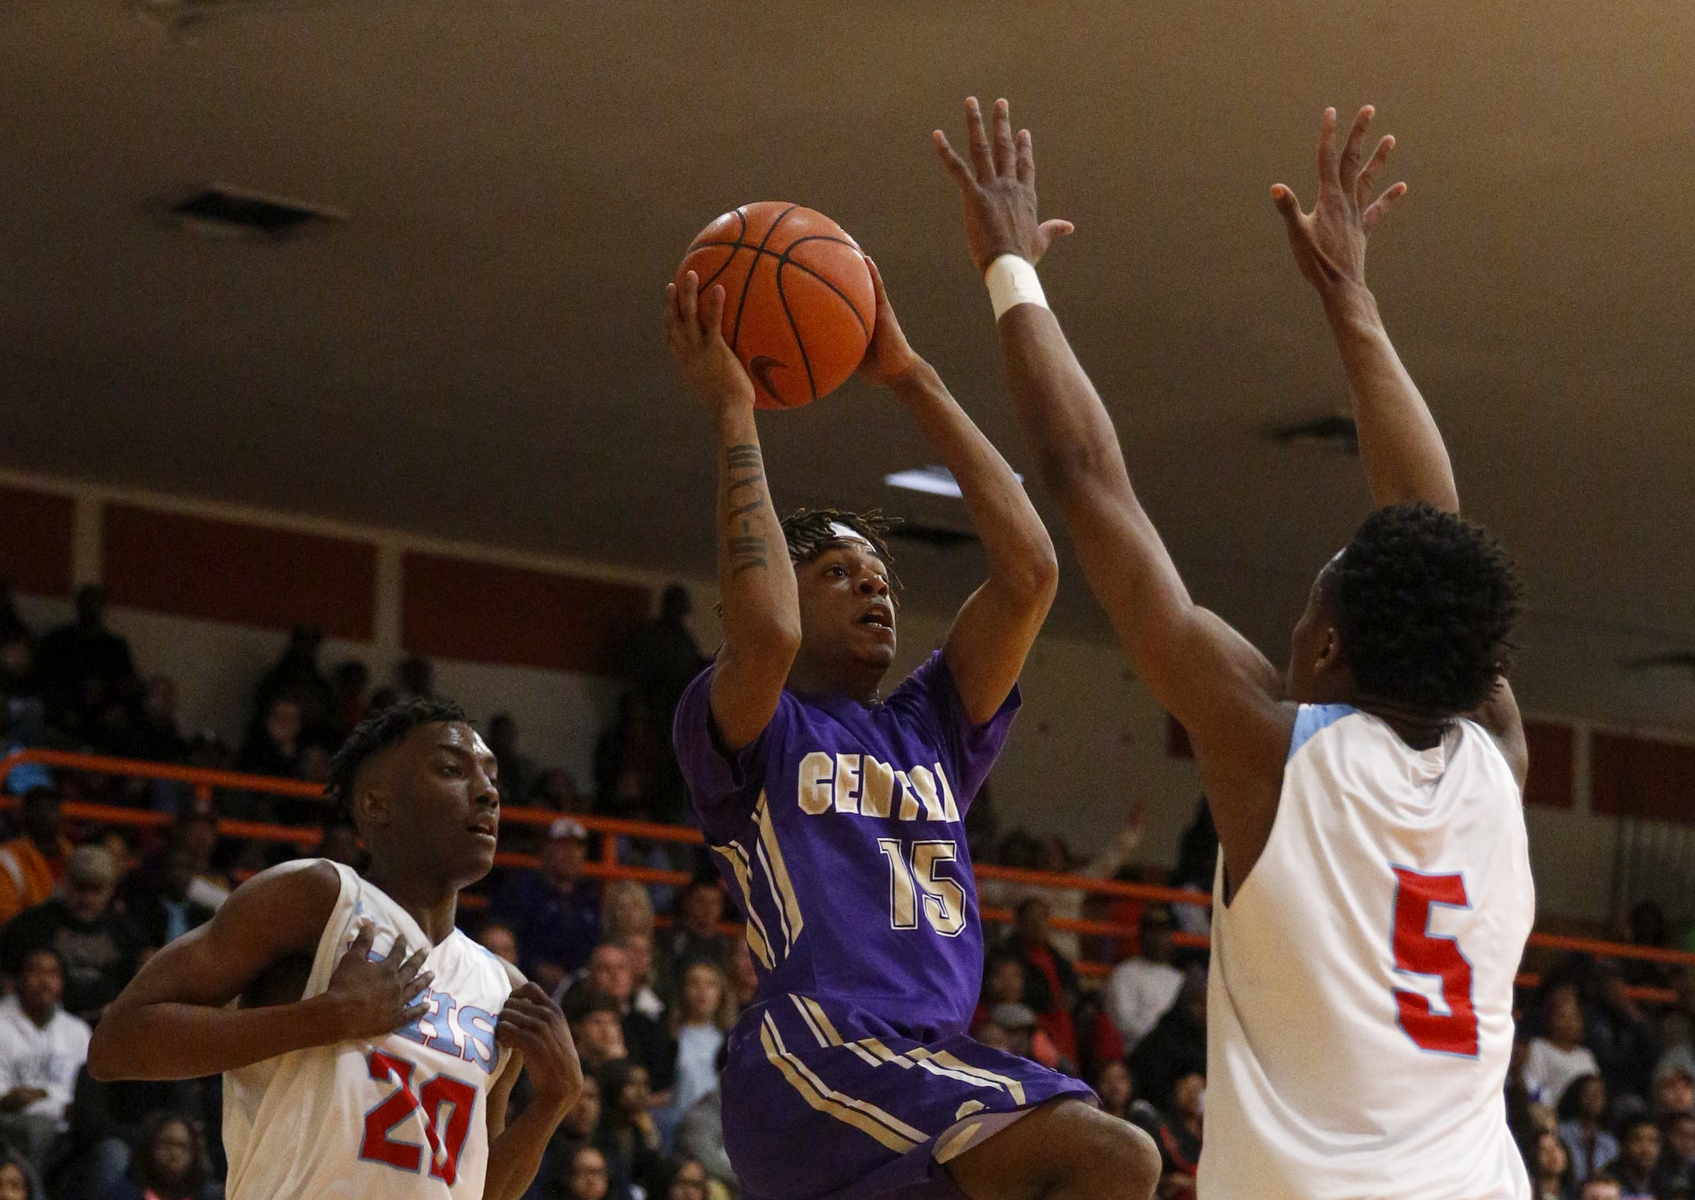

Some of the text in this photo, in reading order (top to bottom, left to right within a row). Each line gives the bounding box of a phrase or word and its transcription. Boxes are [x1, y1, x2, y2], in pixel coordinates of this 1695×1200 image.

[876, 837, 967, 938] 15
[1388, 862, 1481, 1061] 5
[357, 1046, 479, 1187] 20
